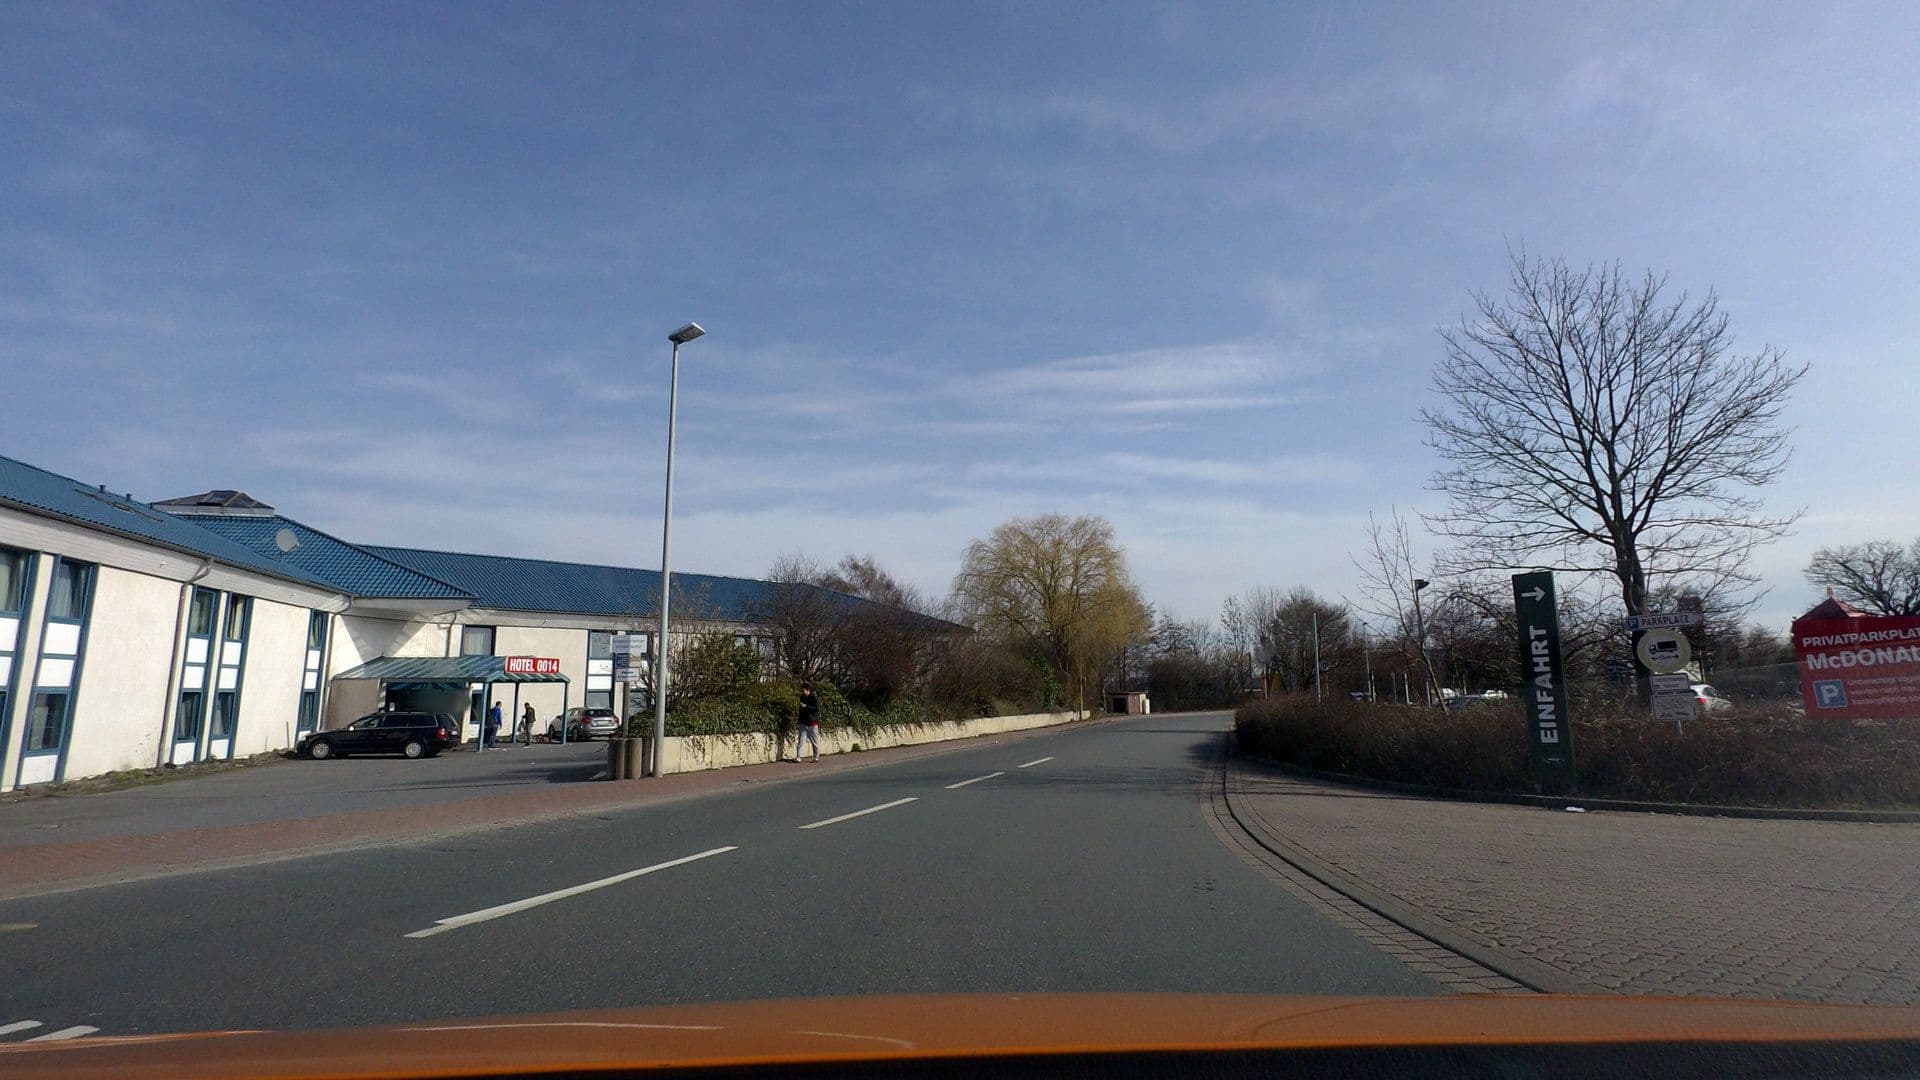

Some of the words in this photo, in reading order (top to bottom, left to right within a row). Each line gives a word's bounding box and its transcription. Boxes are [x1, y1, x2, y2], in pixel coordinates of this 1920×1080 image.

[1642, 614, 1689, 626] PARKPLATZ
[510, 658, 535, 672] HOTEL
[537, 659, 558, 673] 0014
[1529, 625, 1559, 744] EINFAHRT
[1820, 684, 1840, 705] P
